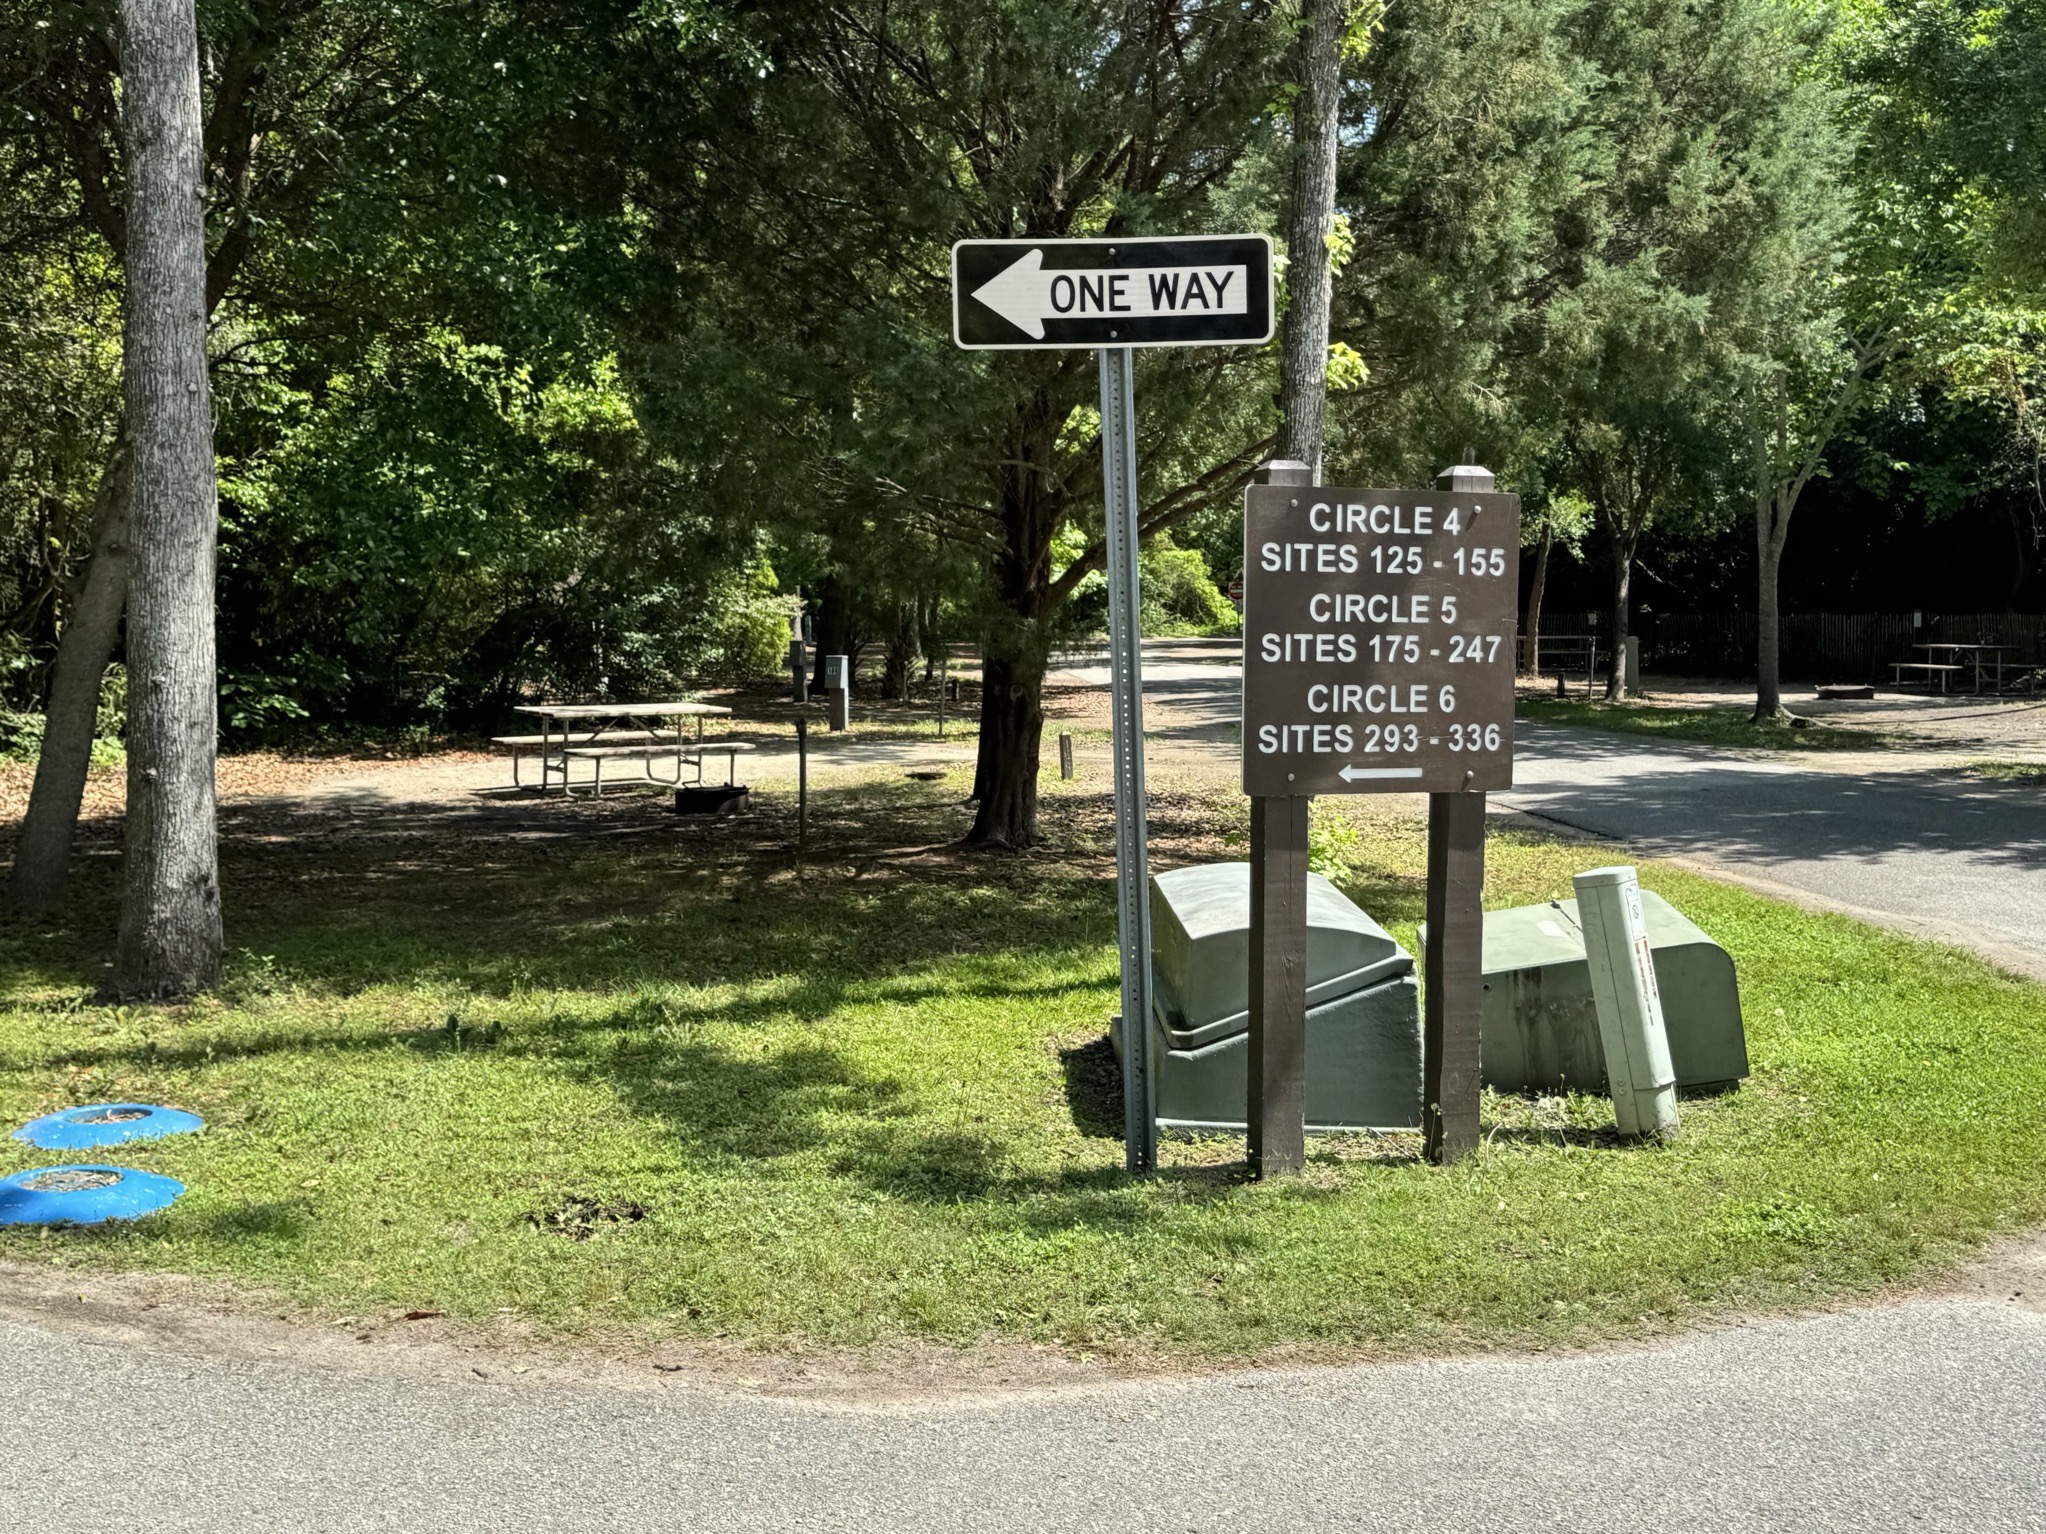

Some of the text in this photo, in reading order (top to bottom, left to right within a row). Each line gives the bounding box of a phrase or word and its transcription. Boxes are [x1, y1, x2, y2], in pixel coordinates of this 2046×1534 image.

[1050, 270, 1235, 314] ONE WAY
[1309, 502, 1462, 536] CIRCLE 4
[1260, 541, 1359, 574] SITES
[1370, 545, 1423, 575] 125
[1453, 546, 1506, 577] 155
[1309, 593, 1457, 625] CIRCLE 5
[1260, 632, 1357, 663] SITES
[1369, 634, 1420, 664] 175
[1448, 634, 1502, 664] 247
[1307, 684, 1456, 714] CIRCLE 6
[1258, 724, 1354, 754] SITES
[1363, 723, 1420, 753] 293
[1448, 723, 1501, 752] 336
